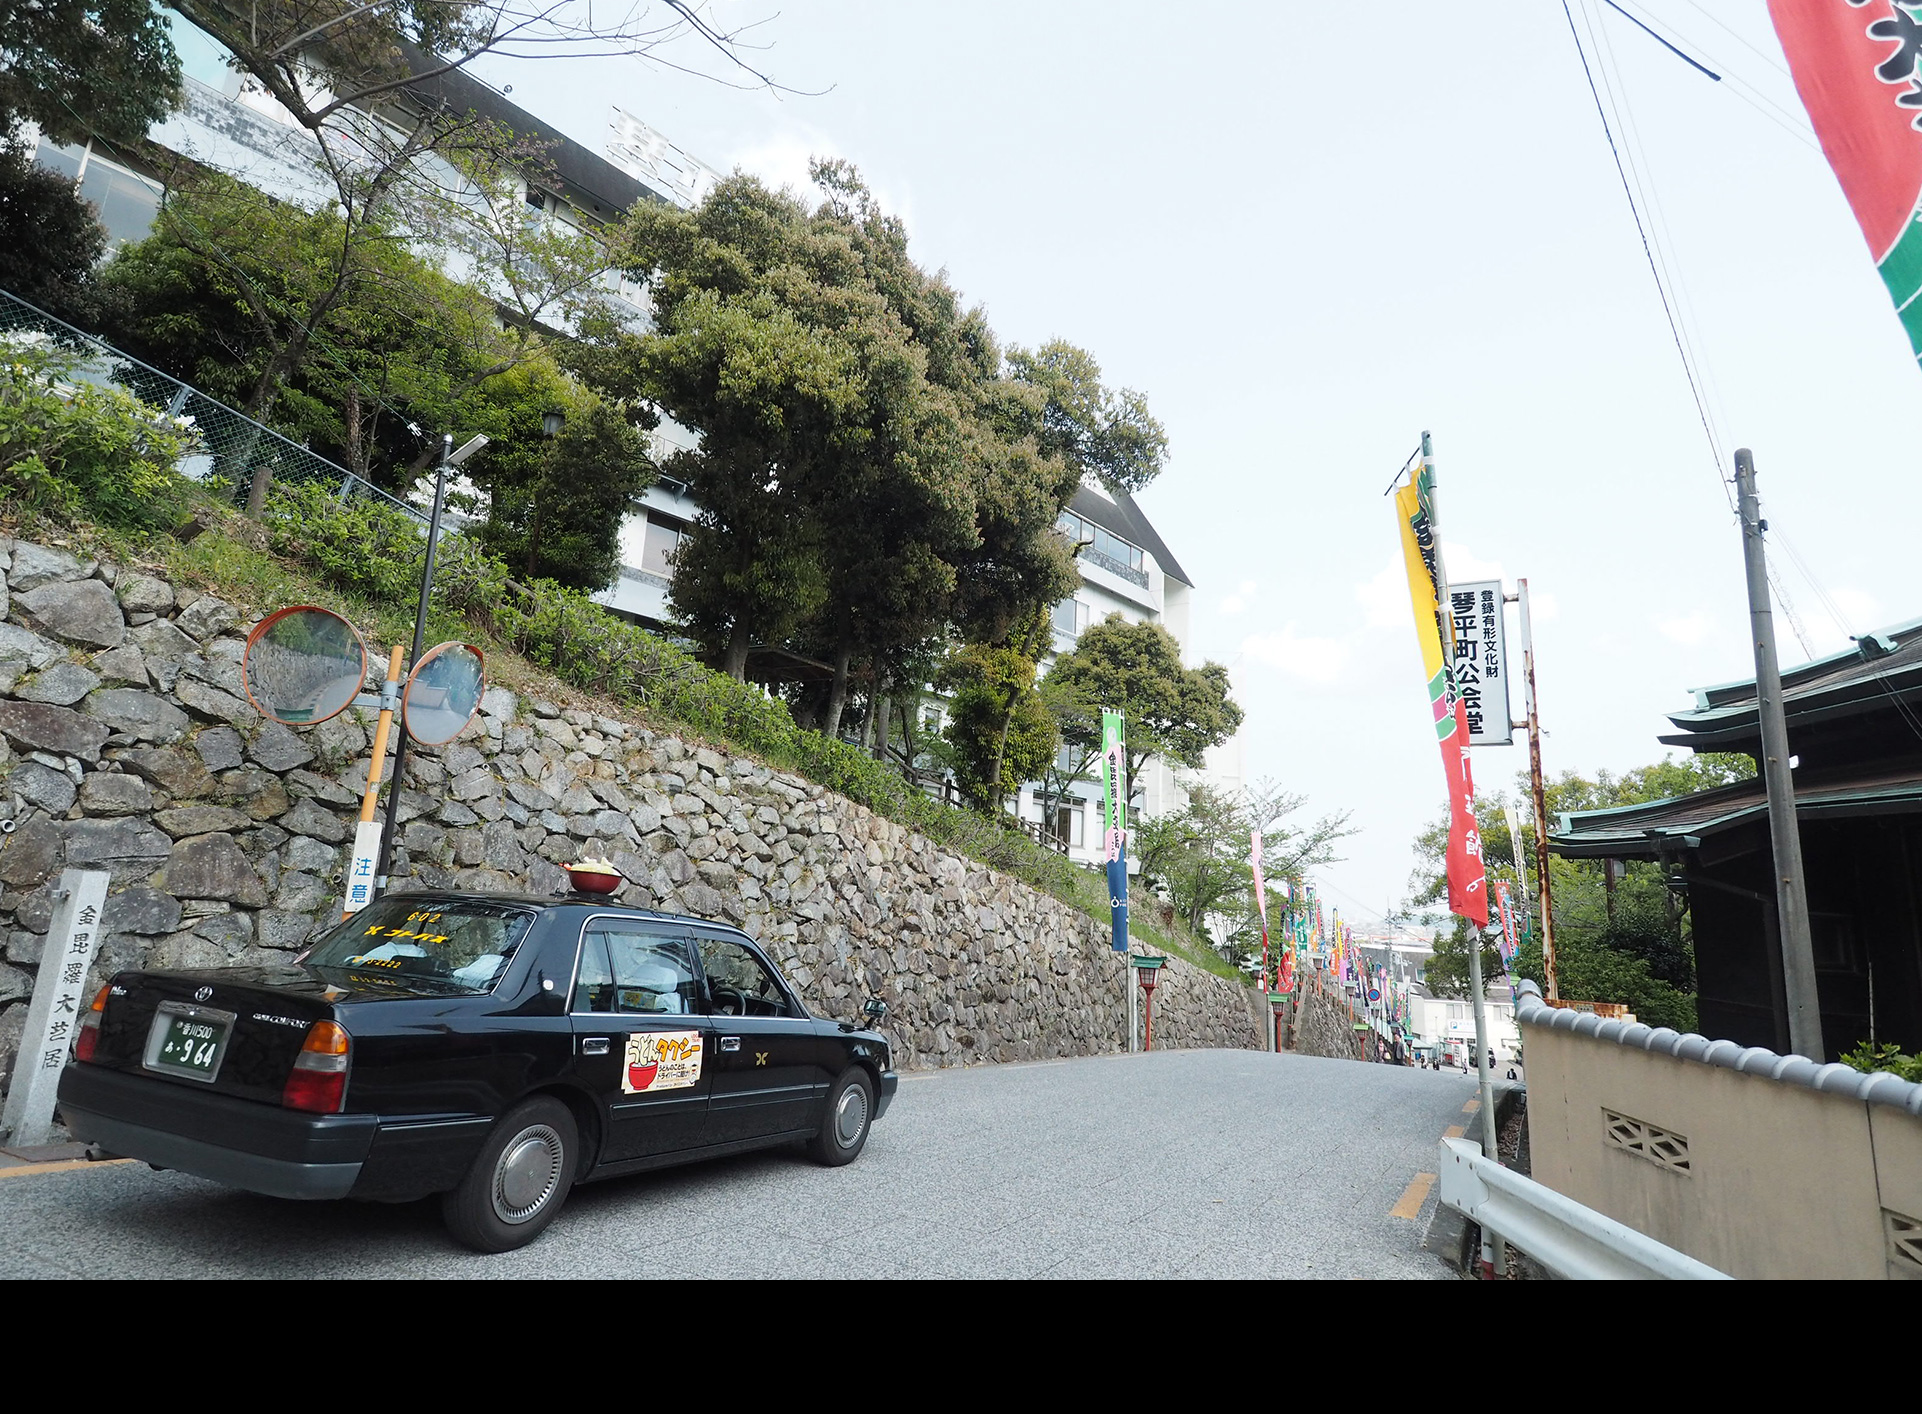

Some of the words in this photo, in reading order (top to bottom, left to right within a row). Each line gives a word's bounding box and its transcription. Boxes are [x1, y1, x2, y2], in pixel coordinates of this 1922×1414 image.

[1480, 589, 1499, 678] 登録有形文化財
[1451, 591, 1483, 736] 琴平町公会堂
[349, 857, 373, 903] 注意
[383, 928, 449, 944] コトバス
[407, 911, 441, 923] 602
[42, 904, 97, 1070] 金毘羅大芝居
[182, 1022, 213, 1039] 香川500
